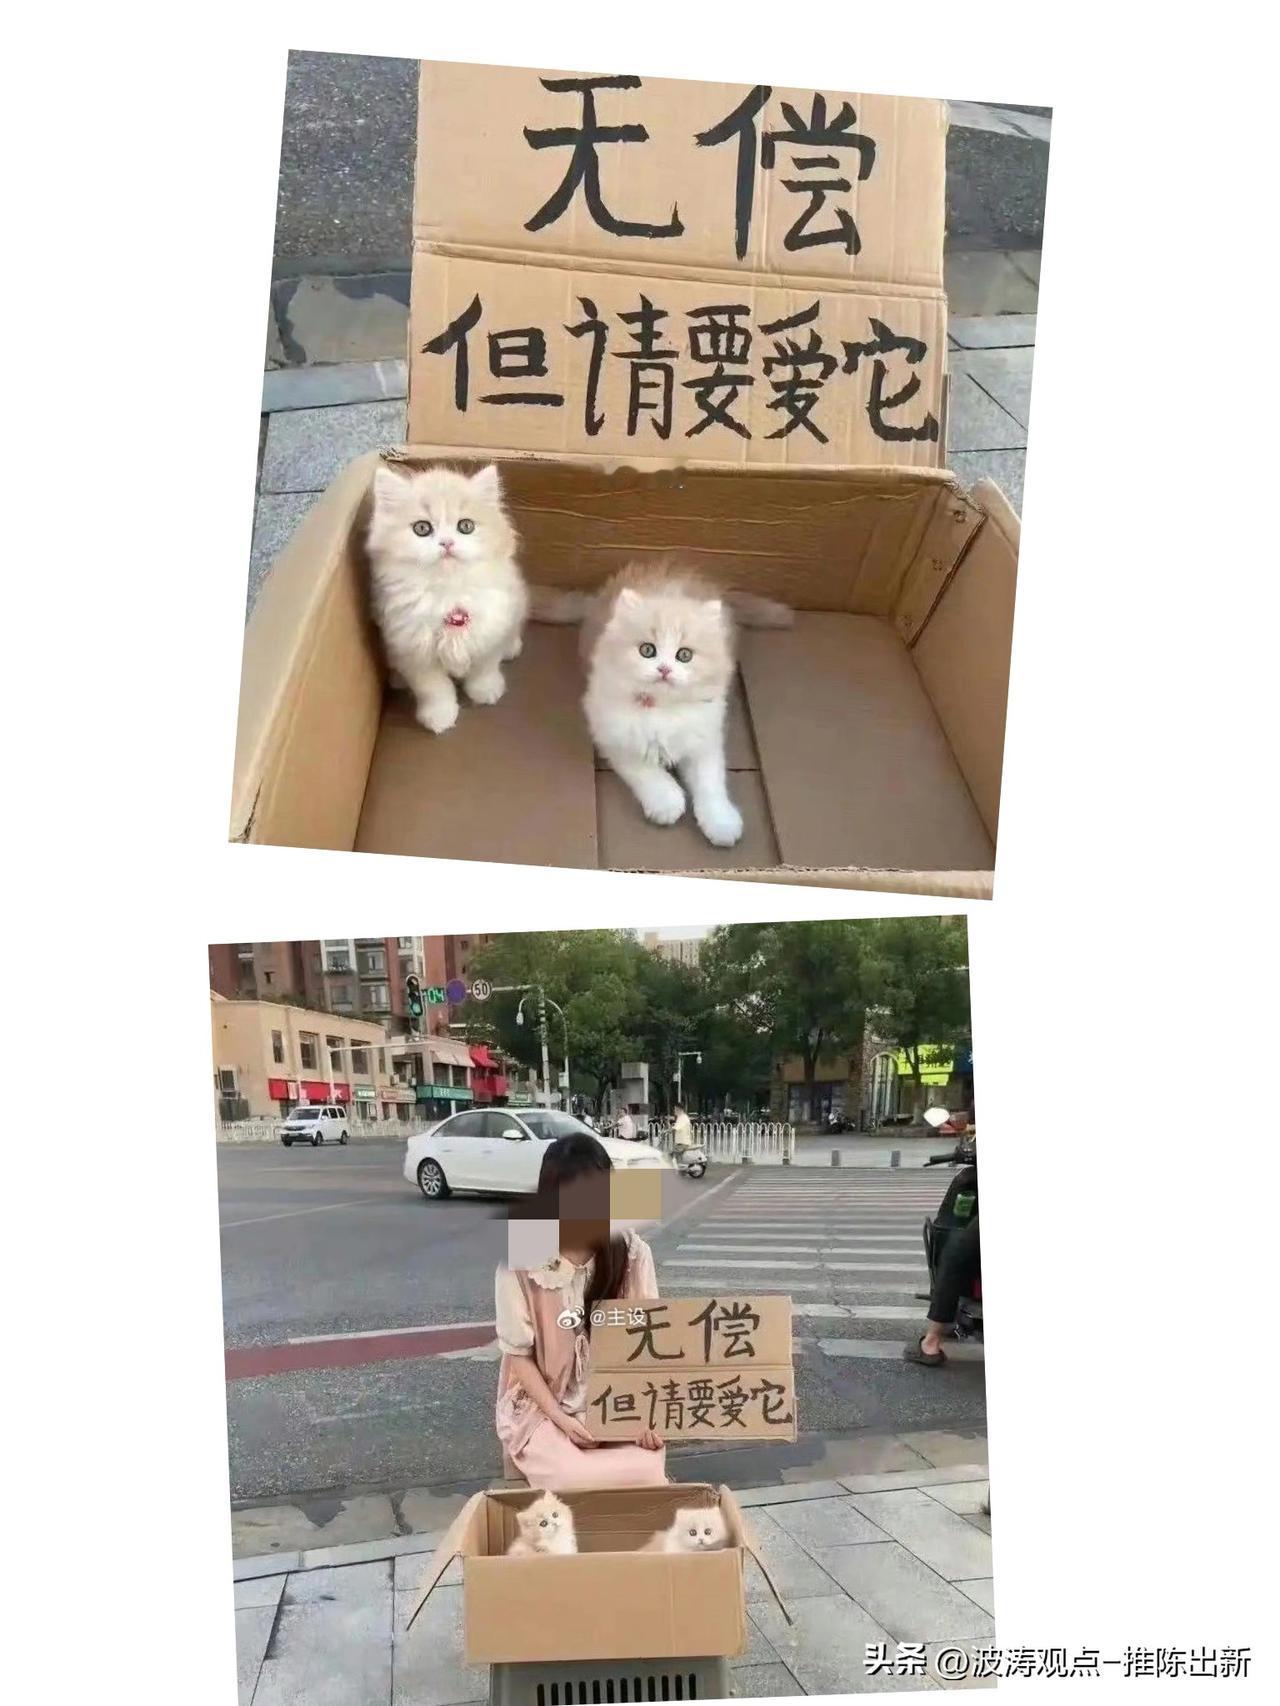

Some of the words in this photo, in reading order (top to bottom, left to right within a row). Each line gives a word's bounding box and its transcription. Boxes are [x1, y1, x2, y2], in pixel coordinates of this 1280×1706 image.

[523, 75, 876, 261] 无偿
[421, 292, 939, 444] 但请要爱它
[474, 983, 488, 997] 50
[625, 1299, 761, 1364] 无偿
[590, 1374, 793, 1431] 但请要爱它
